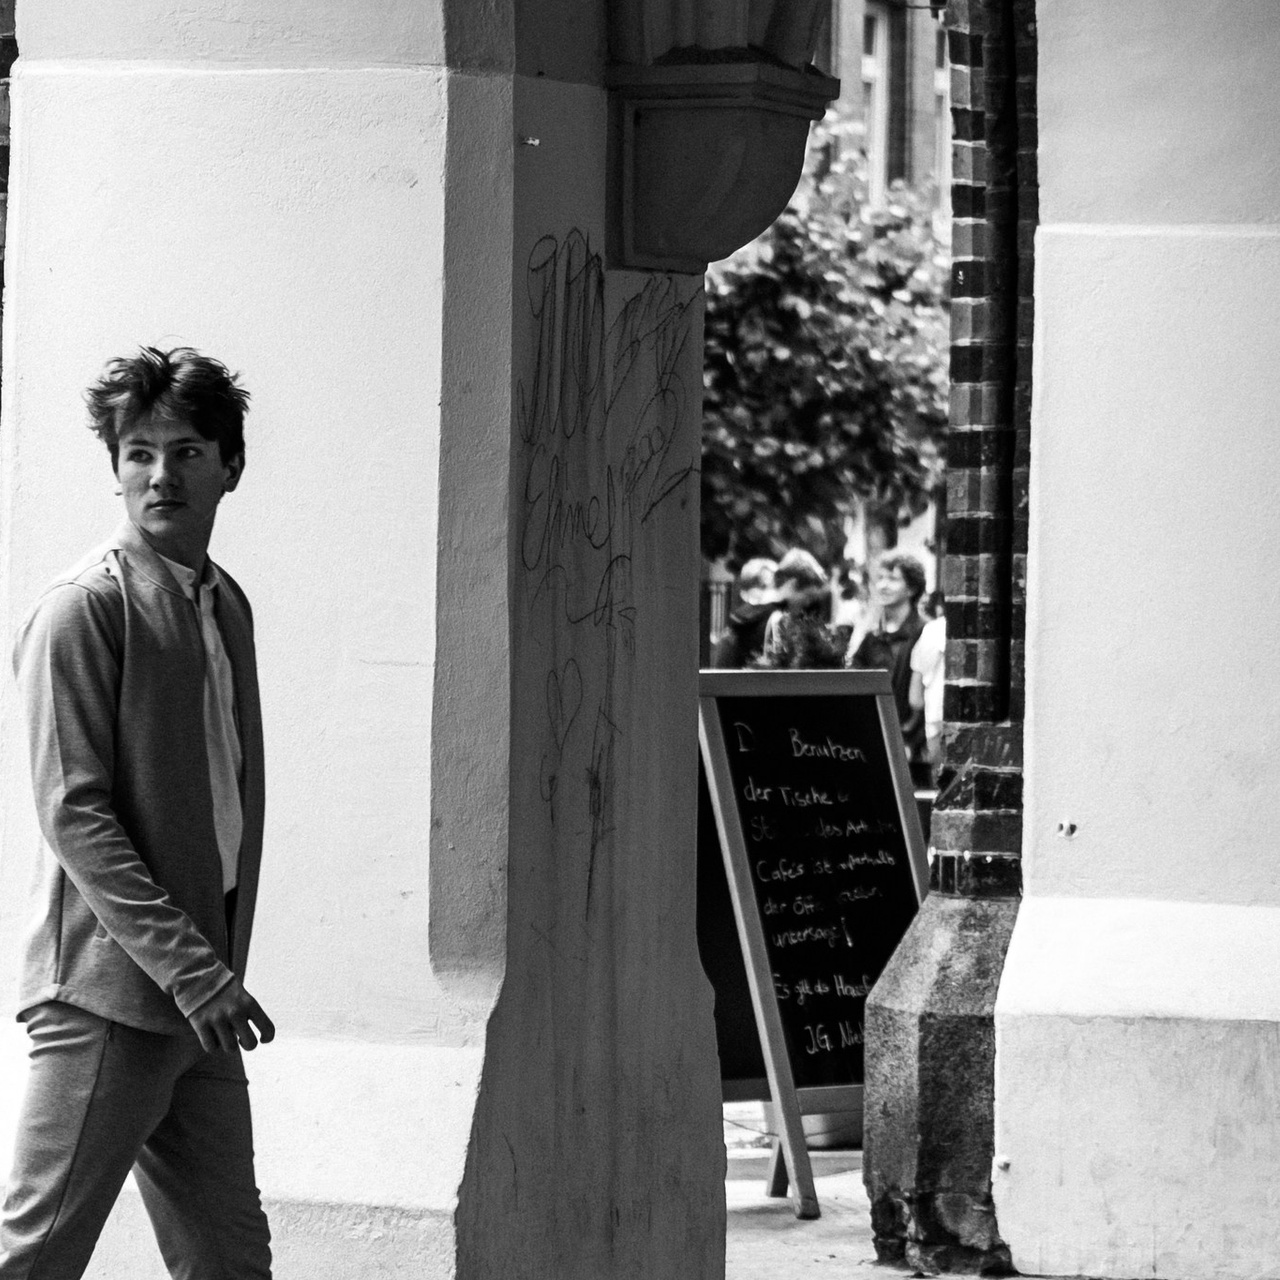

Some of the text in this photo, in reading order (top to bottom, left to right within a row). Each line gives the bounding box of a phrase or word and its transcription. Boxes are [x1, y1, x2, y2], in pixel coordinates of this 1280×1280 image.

[788, 727, 867, 763] Benutzen
[743, 776, 771, 802] der
[777, 786, 832, 807] Tische
